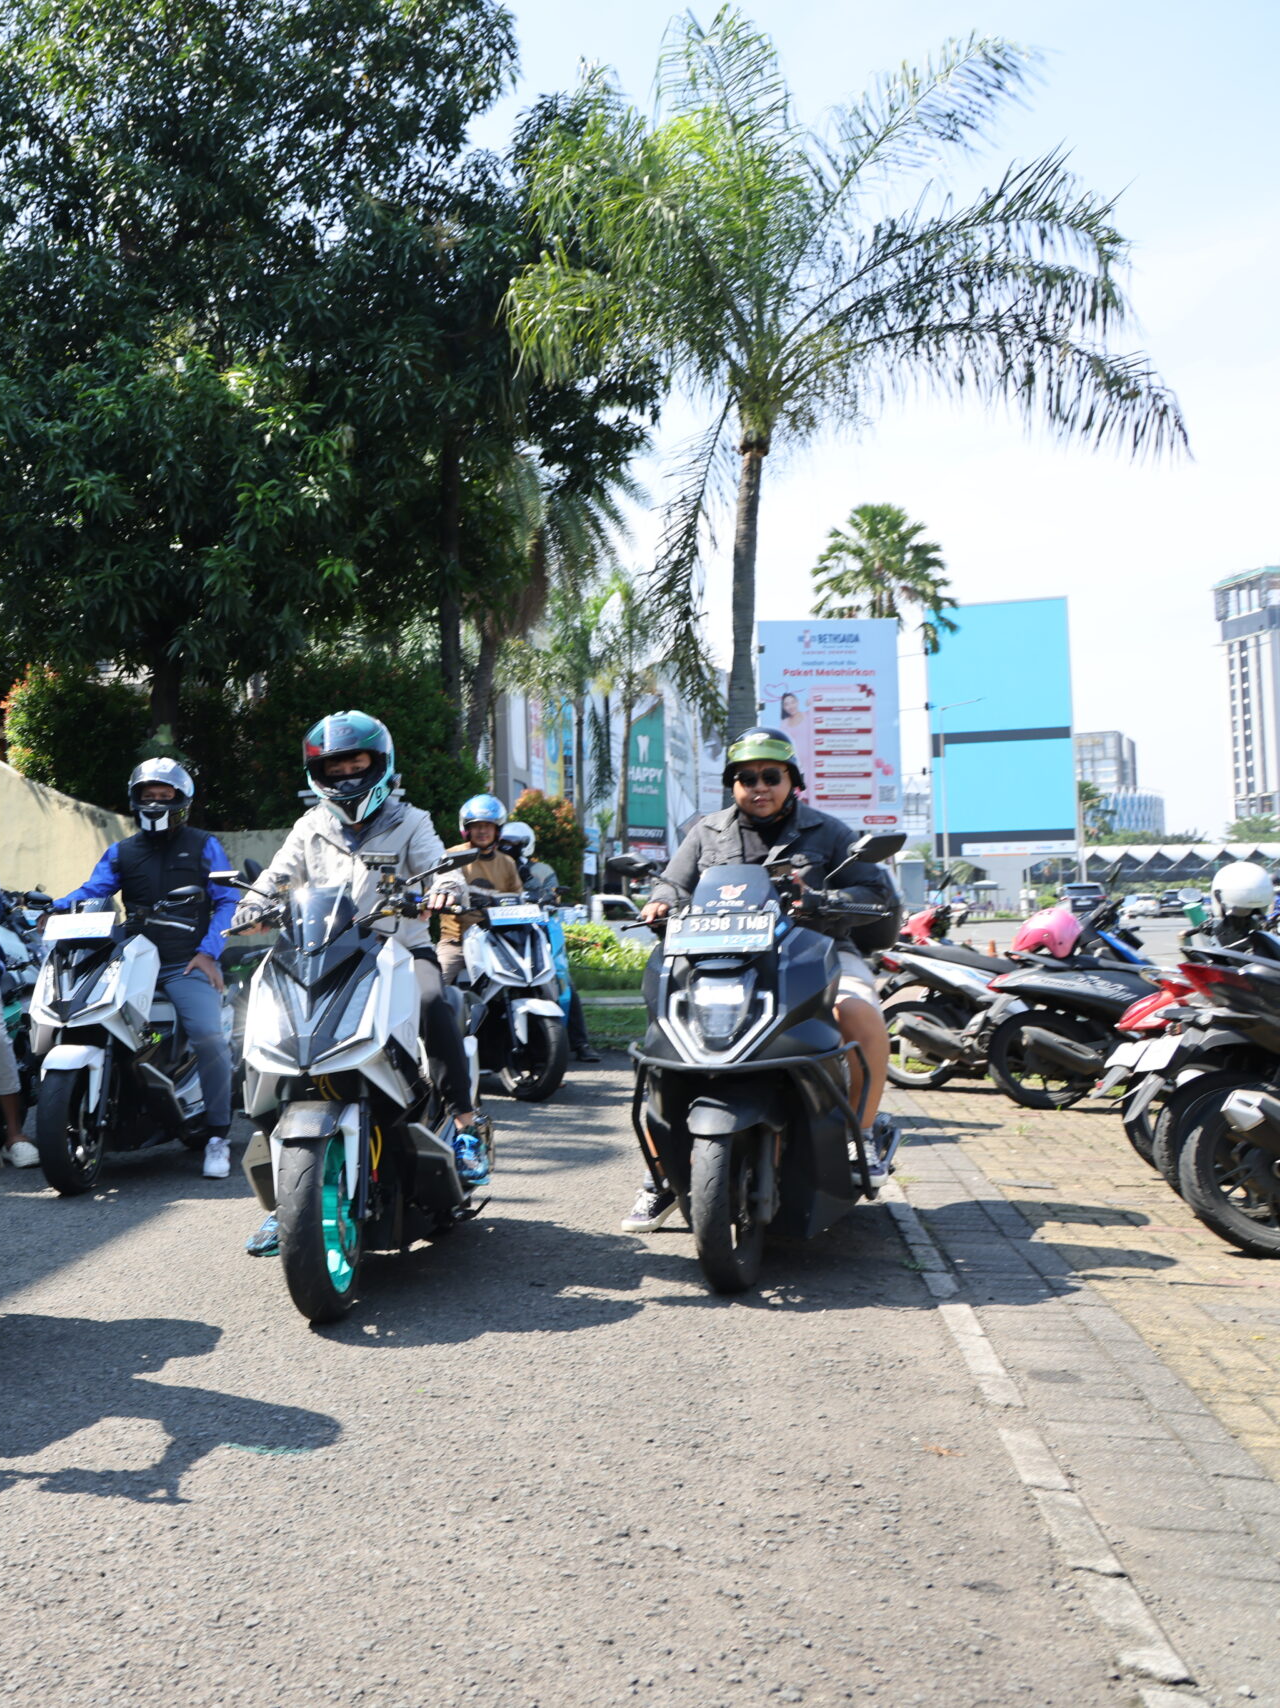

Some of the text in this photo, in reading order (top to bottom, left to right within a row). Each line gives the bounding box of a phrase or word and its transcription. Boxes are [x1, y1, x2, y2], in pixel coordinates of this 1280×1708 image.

[783, 668, 876, 677] Paket Melahirkan
[627, 766, 664, 783] HAPPY
[690, 916, 731, 932] 5398
